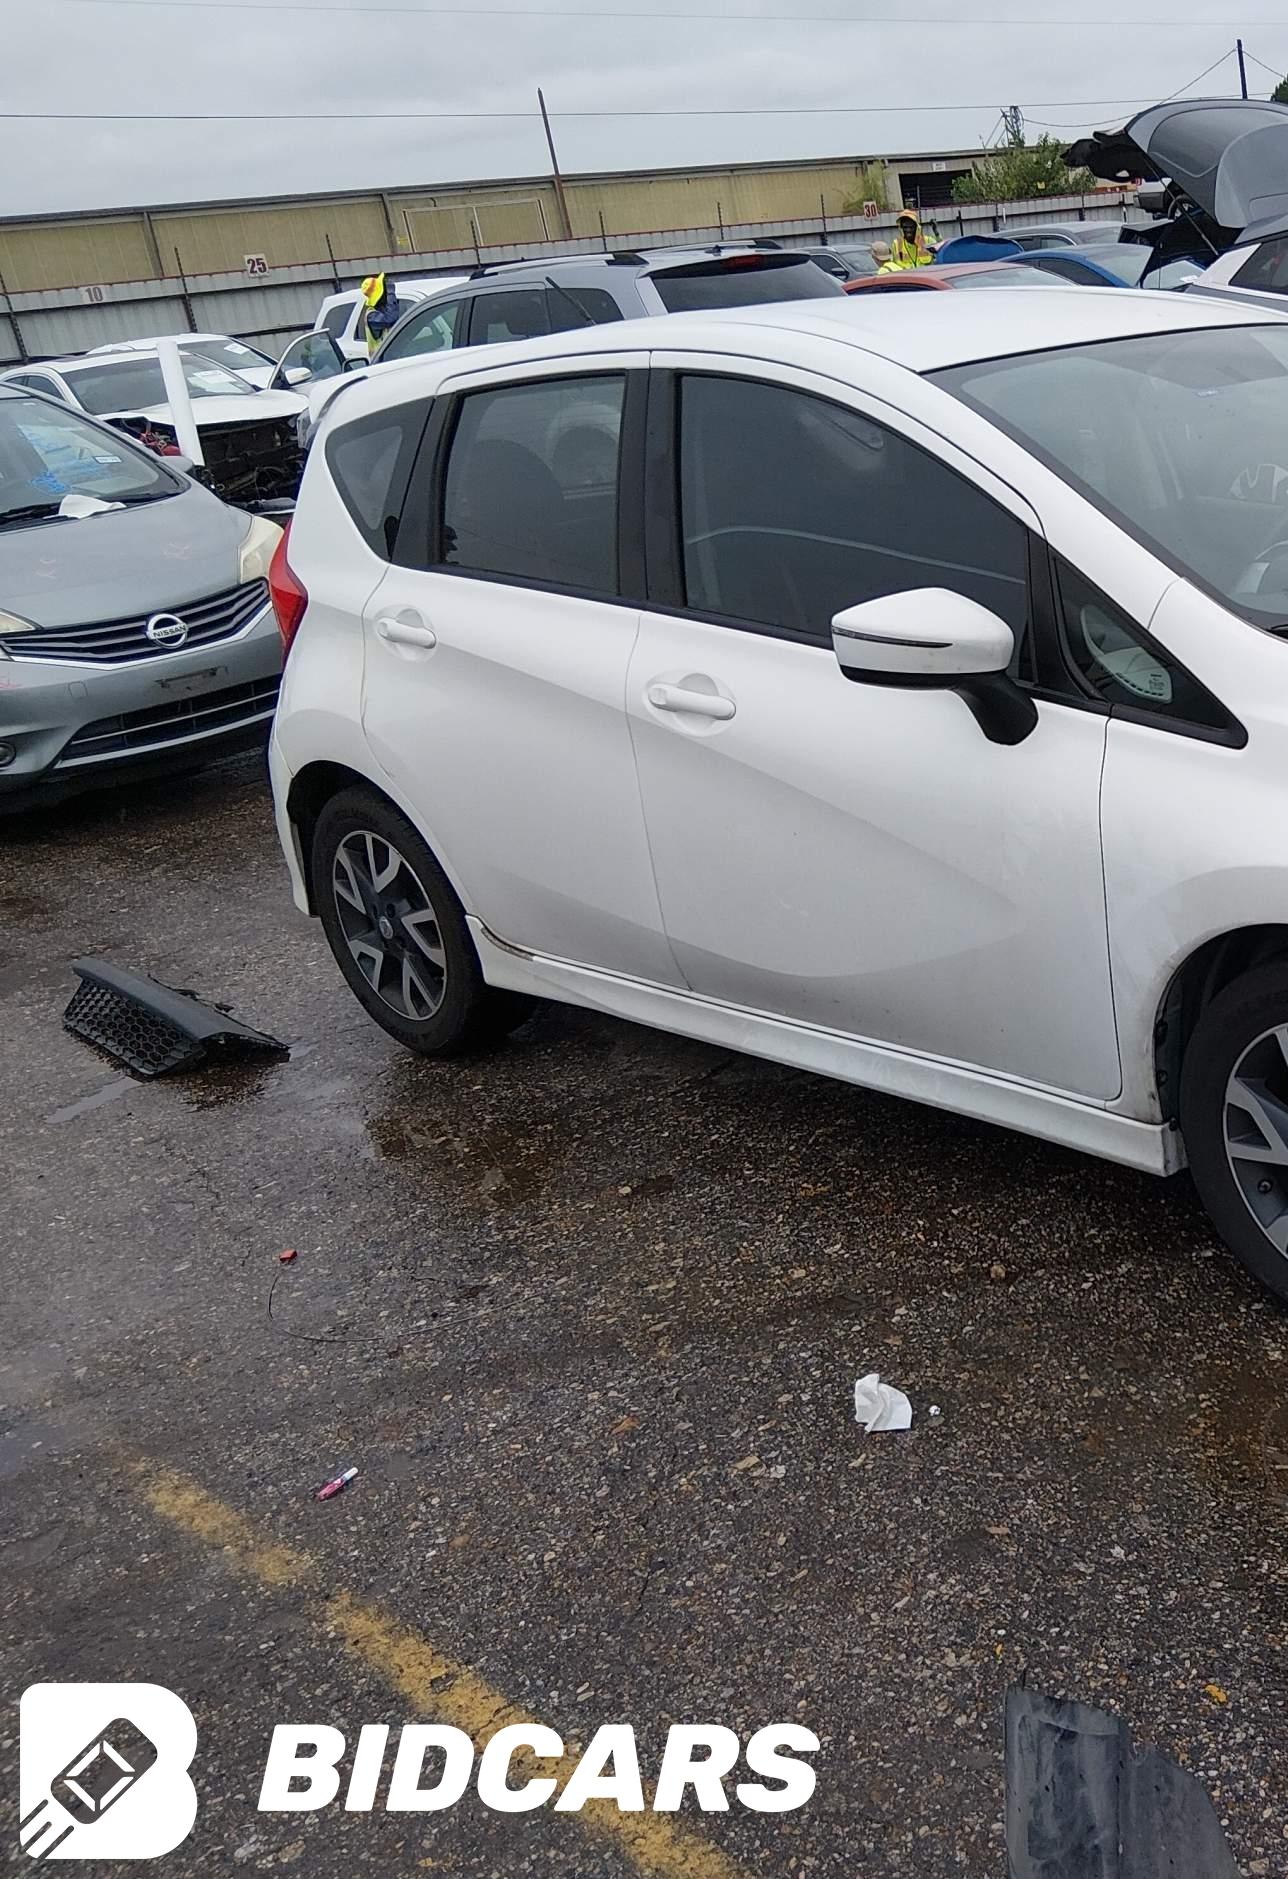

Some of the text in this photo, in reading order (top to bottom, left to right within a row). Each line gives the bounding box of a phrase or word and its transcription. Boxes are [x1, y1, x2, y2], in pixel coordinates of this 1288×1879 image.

[864, 203, 877, 218] 30
[247, 258, 267, 274] 25
[85, 286, 104, 303] 10
[153, 624, 186, 637] NISSAN
